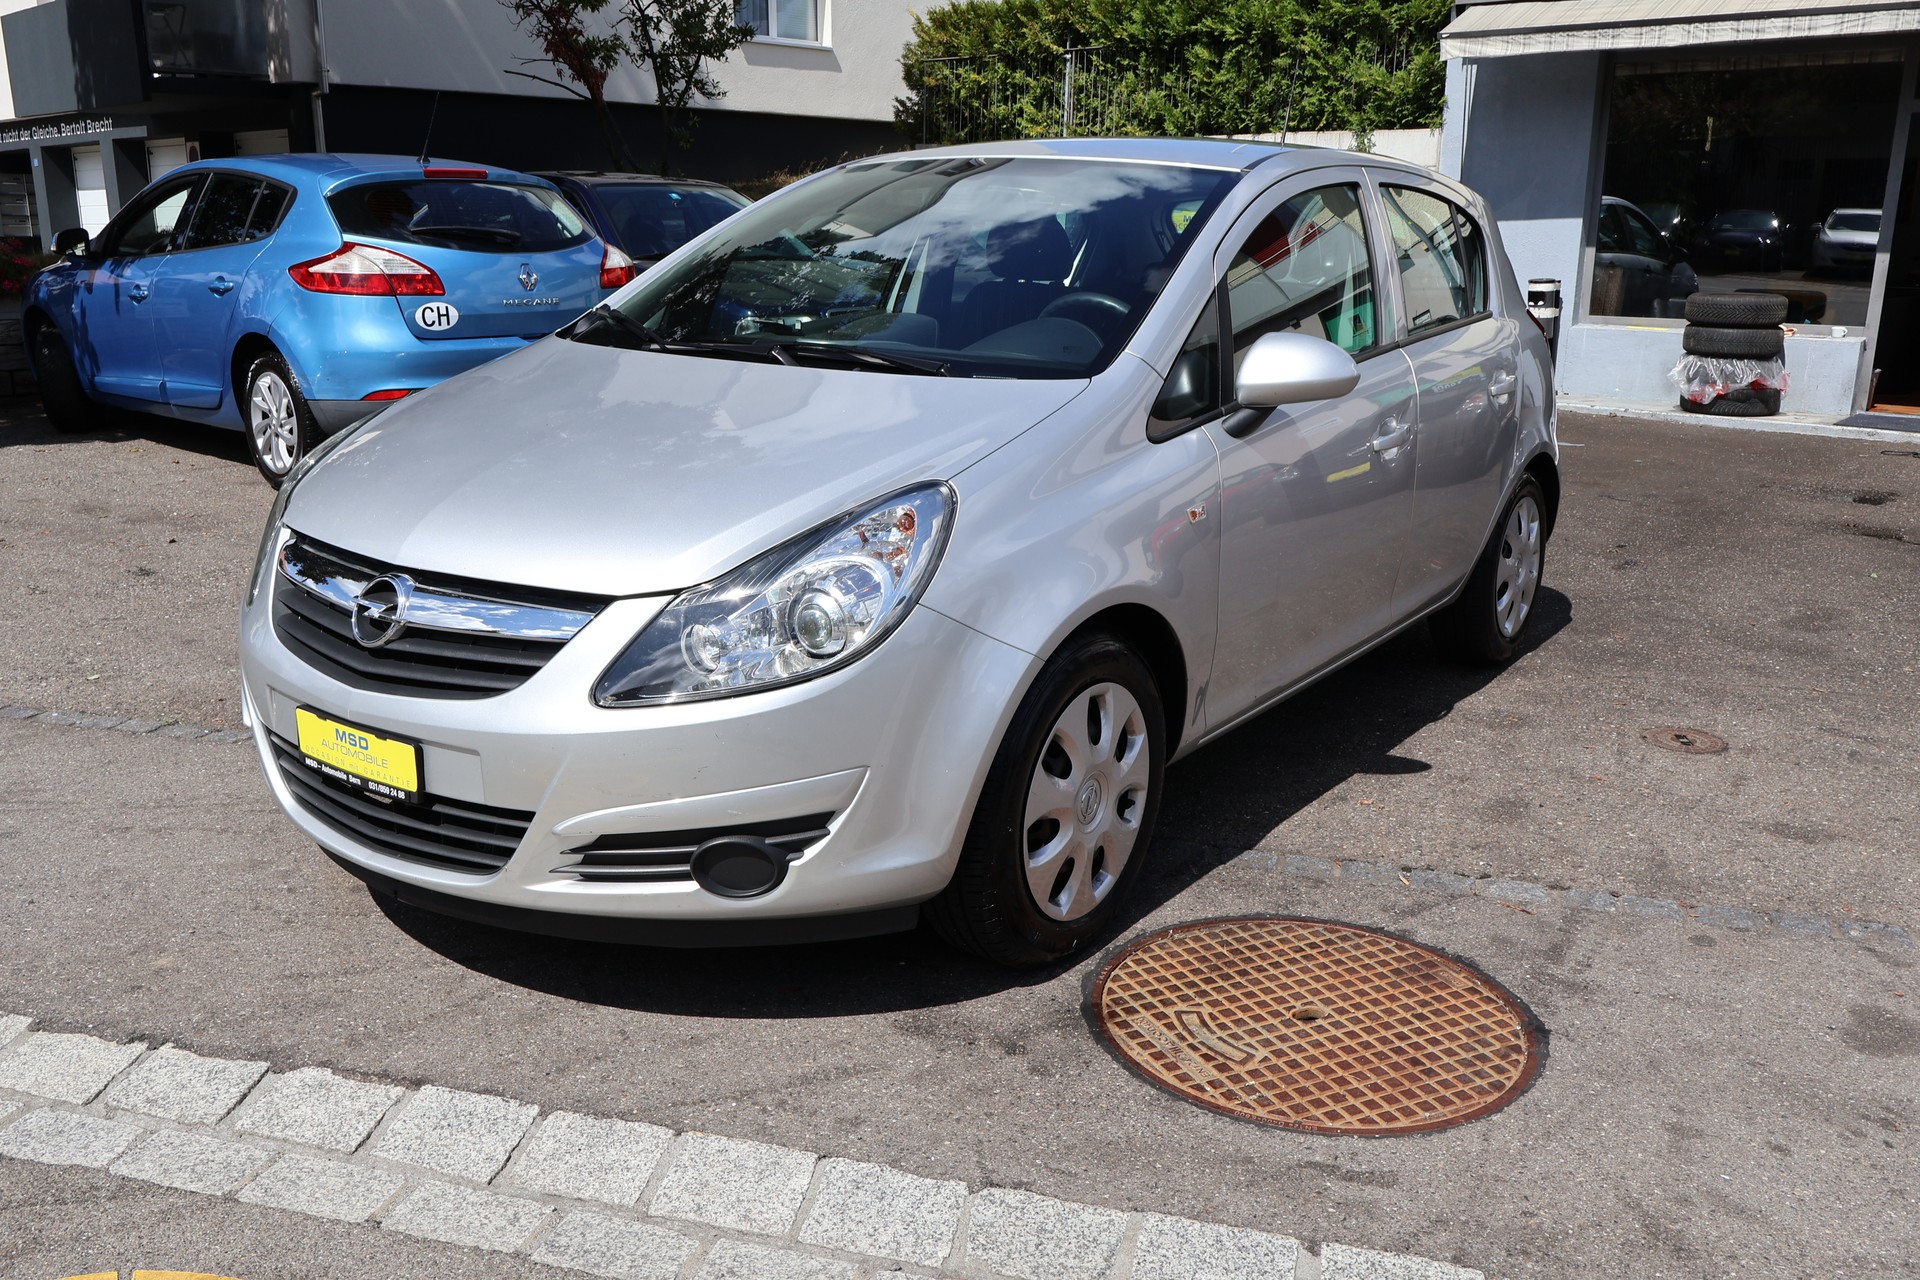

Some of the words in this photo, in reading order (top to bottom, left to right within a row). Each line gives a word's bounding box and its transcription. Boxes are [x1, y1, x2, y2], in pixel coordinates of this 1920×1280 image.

[3, 129, 19, 142] nicht
[20, 128, 31, 140] der
[61, 120, 85, 136] Bertolt
[87, 117, 112, 133] Brecht
[503, 298, 560, 306] MEGANE
[421, 305, 451, 328] CH
[335, 728, 369, 750] MSD
[321, 738, 389, 769] AUTOMOBILE
[321, 764, 347, 780] Automobile
[349, 775, 361, 785] Bern
[390, 787, 398, 797] 24
[363, 766, 412, 789] GARANTIE
